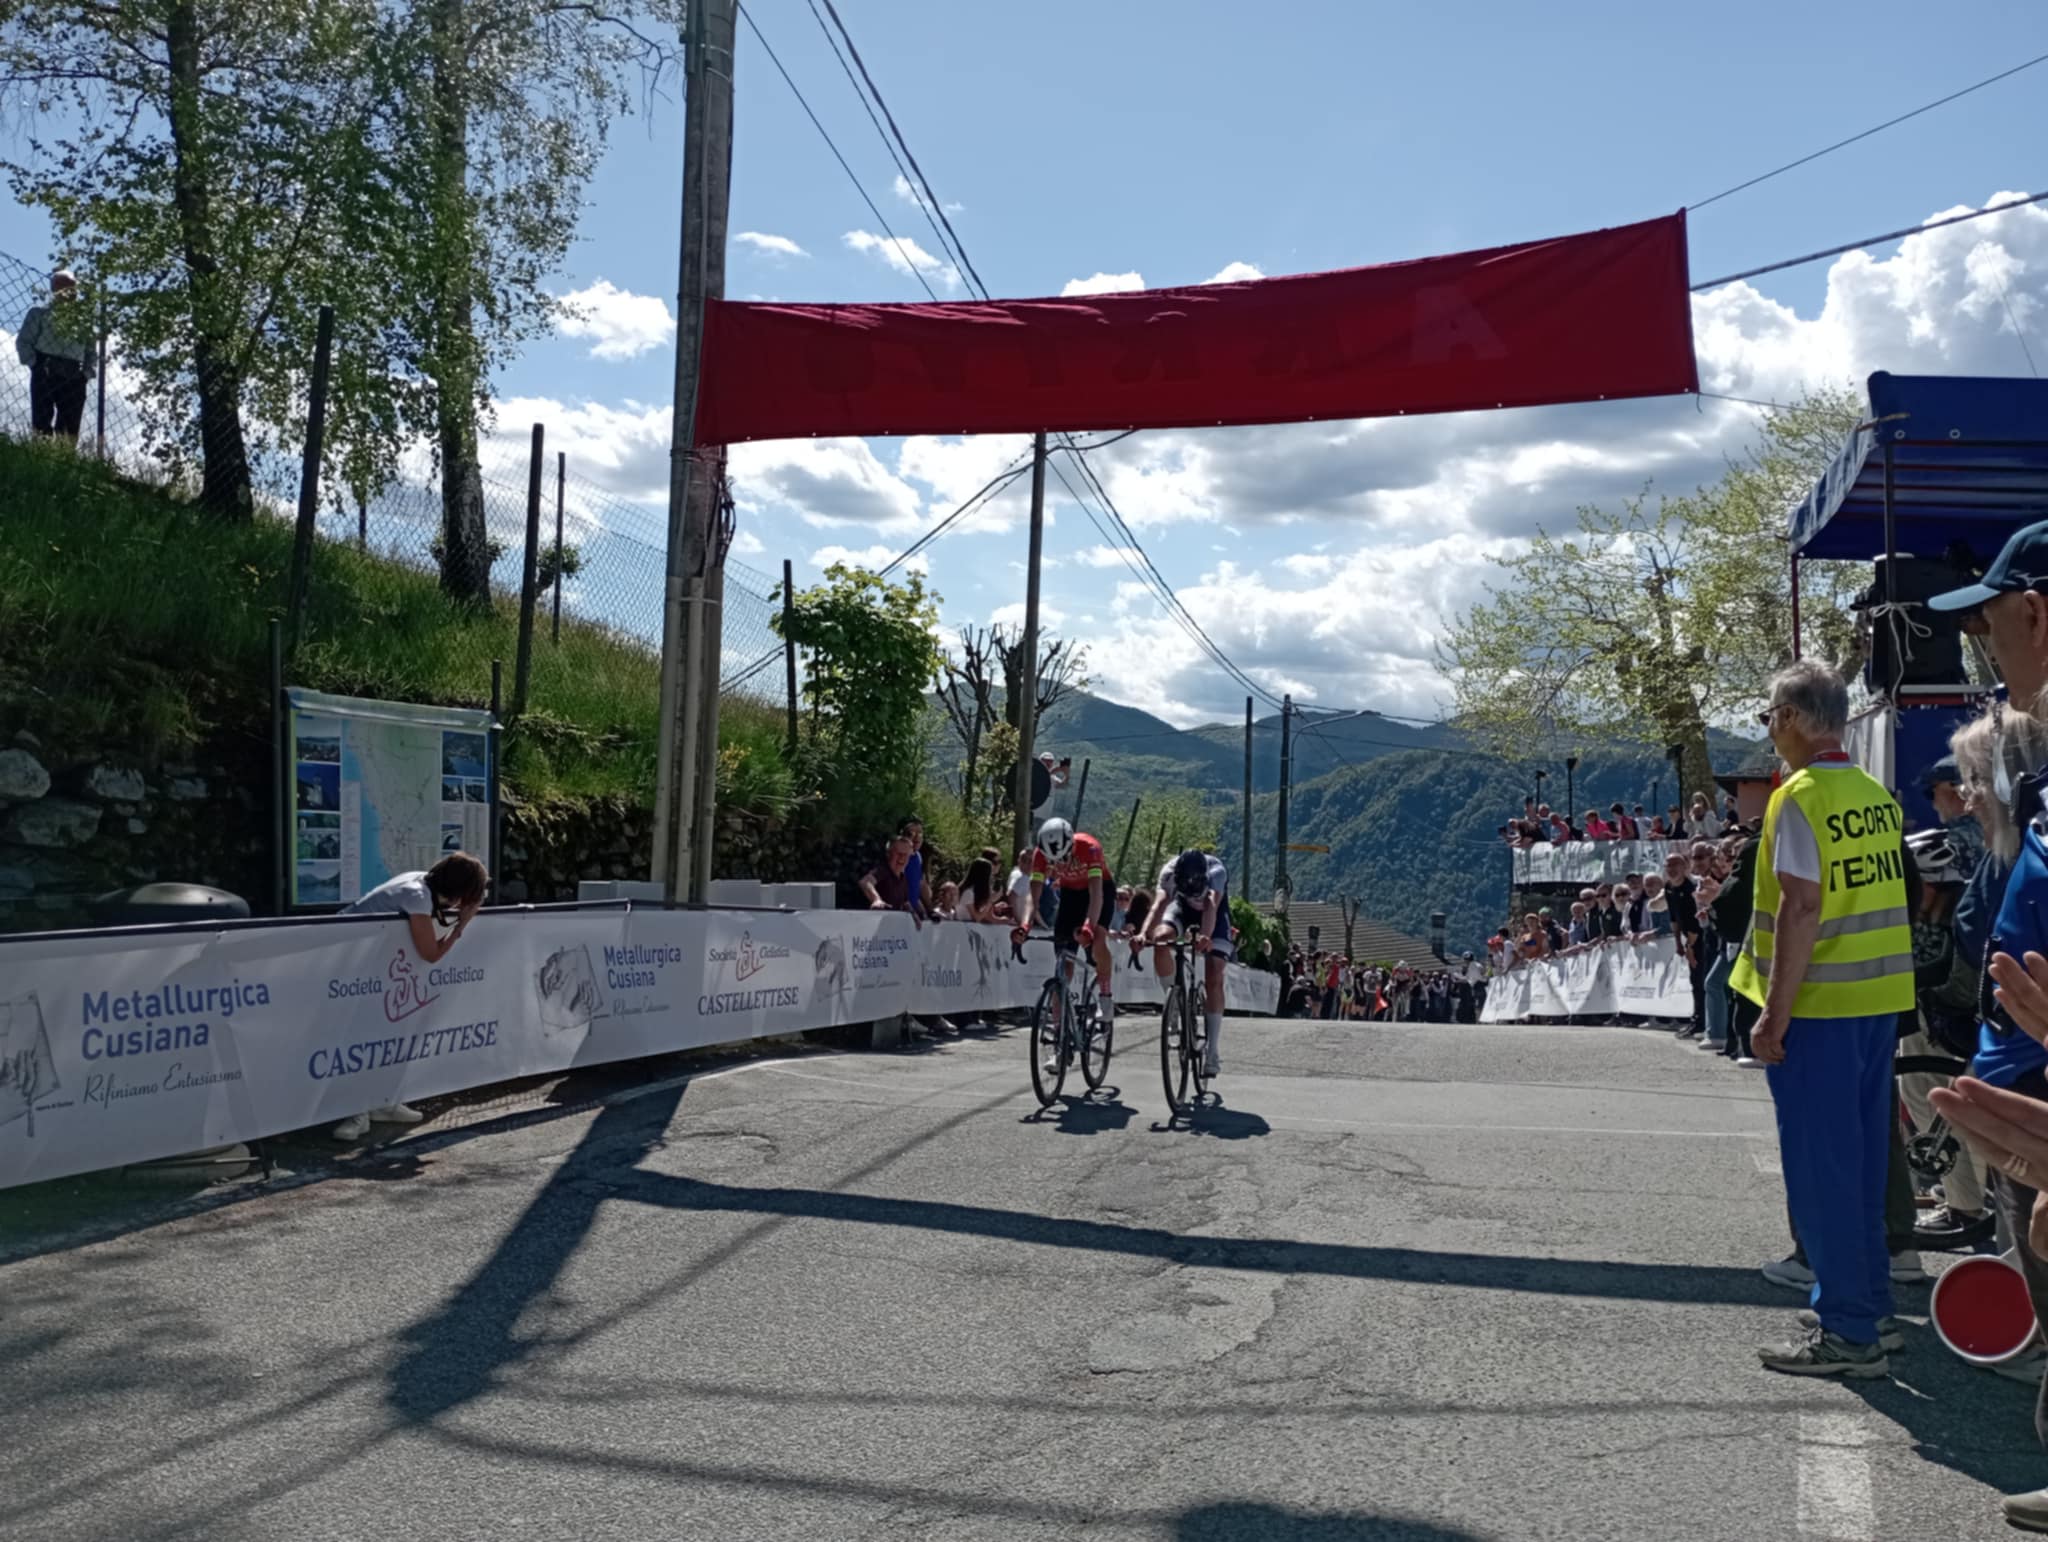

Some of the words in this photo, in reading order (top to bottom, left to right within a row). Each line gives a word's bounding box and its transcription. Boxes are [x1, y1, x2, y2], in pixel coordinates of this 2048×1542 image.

[603, 943, 681, 968] Metallurgica
[852, 935, 908, 954] Metallurgica
[852, 952, 889, 970] Cusiana
[328, 977, 383, 999] Società
[428, 966, 485, 987] Ciclistica
[607, 967, 656, 990] Cusiana
[81, 979, 271, 1026] Metallurgica
[697, 986, 800, 1016] CASTELLETTESE
[81, 1022, 210, 1061] Cusiana
[308, 1020, 499, 1081] CASTELLETTESE
[83, 1072, 159, 1109] Rifiniamo
[162, 1062, 243, 1091] Entusiasmo
